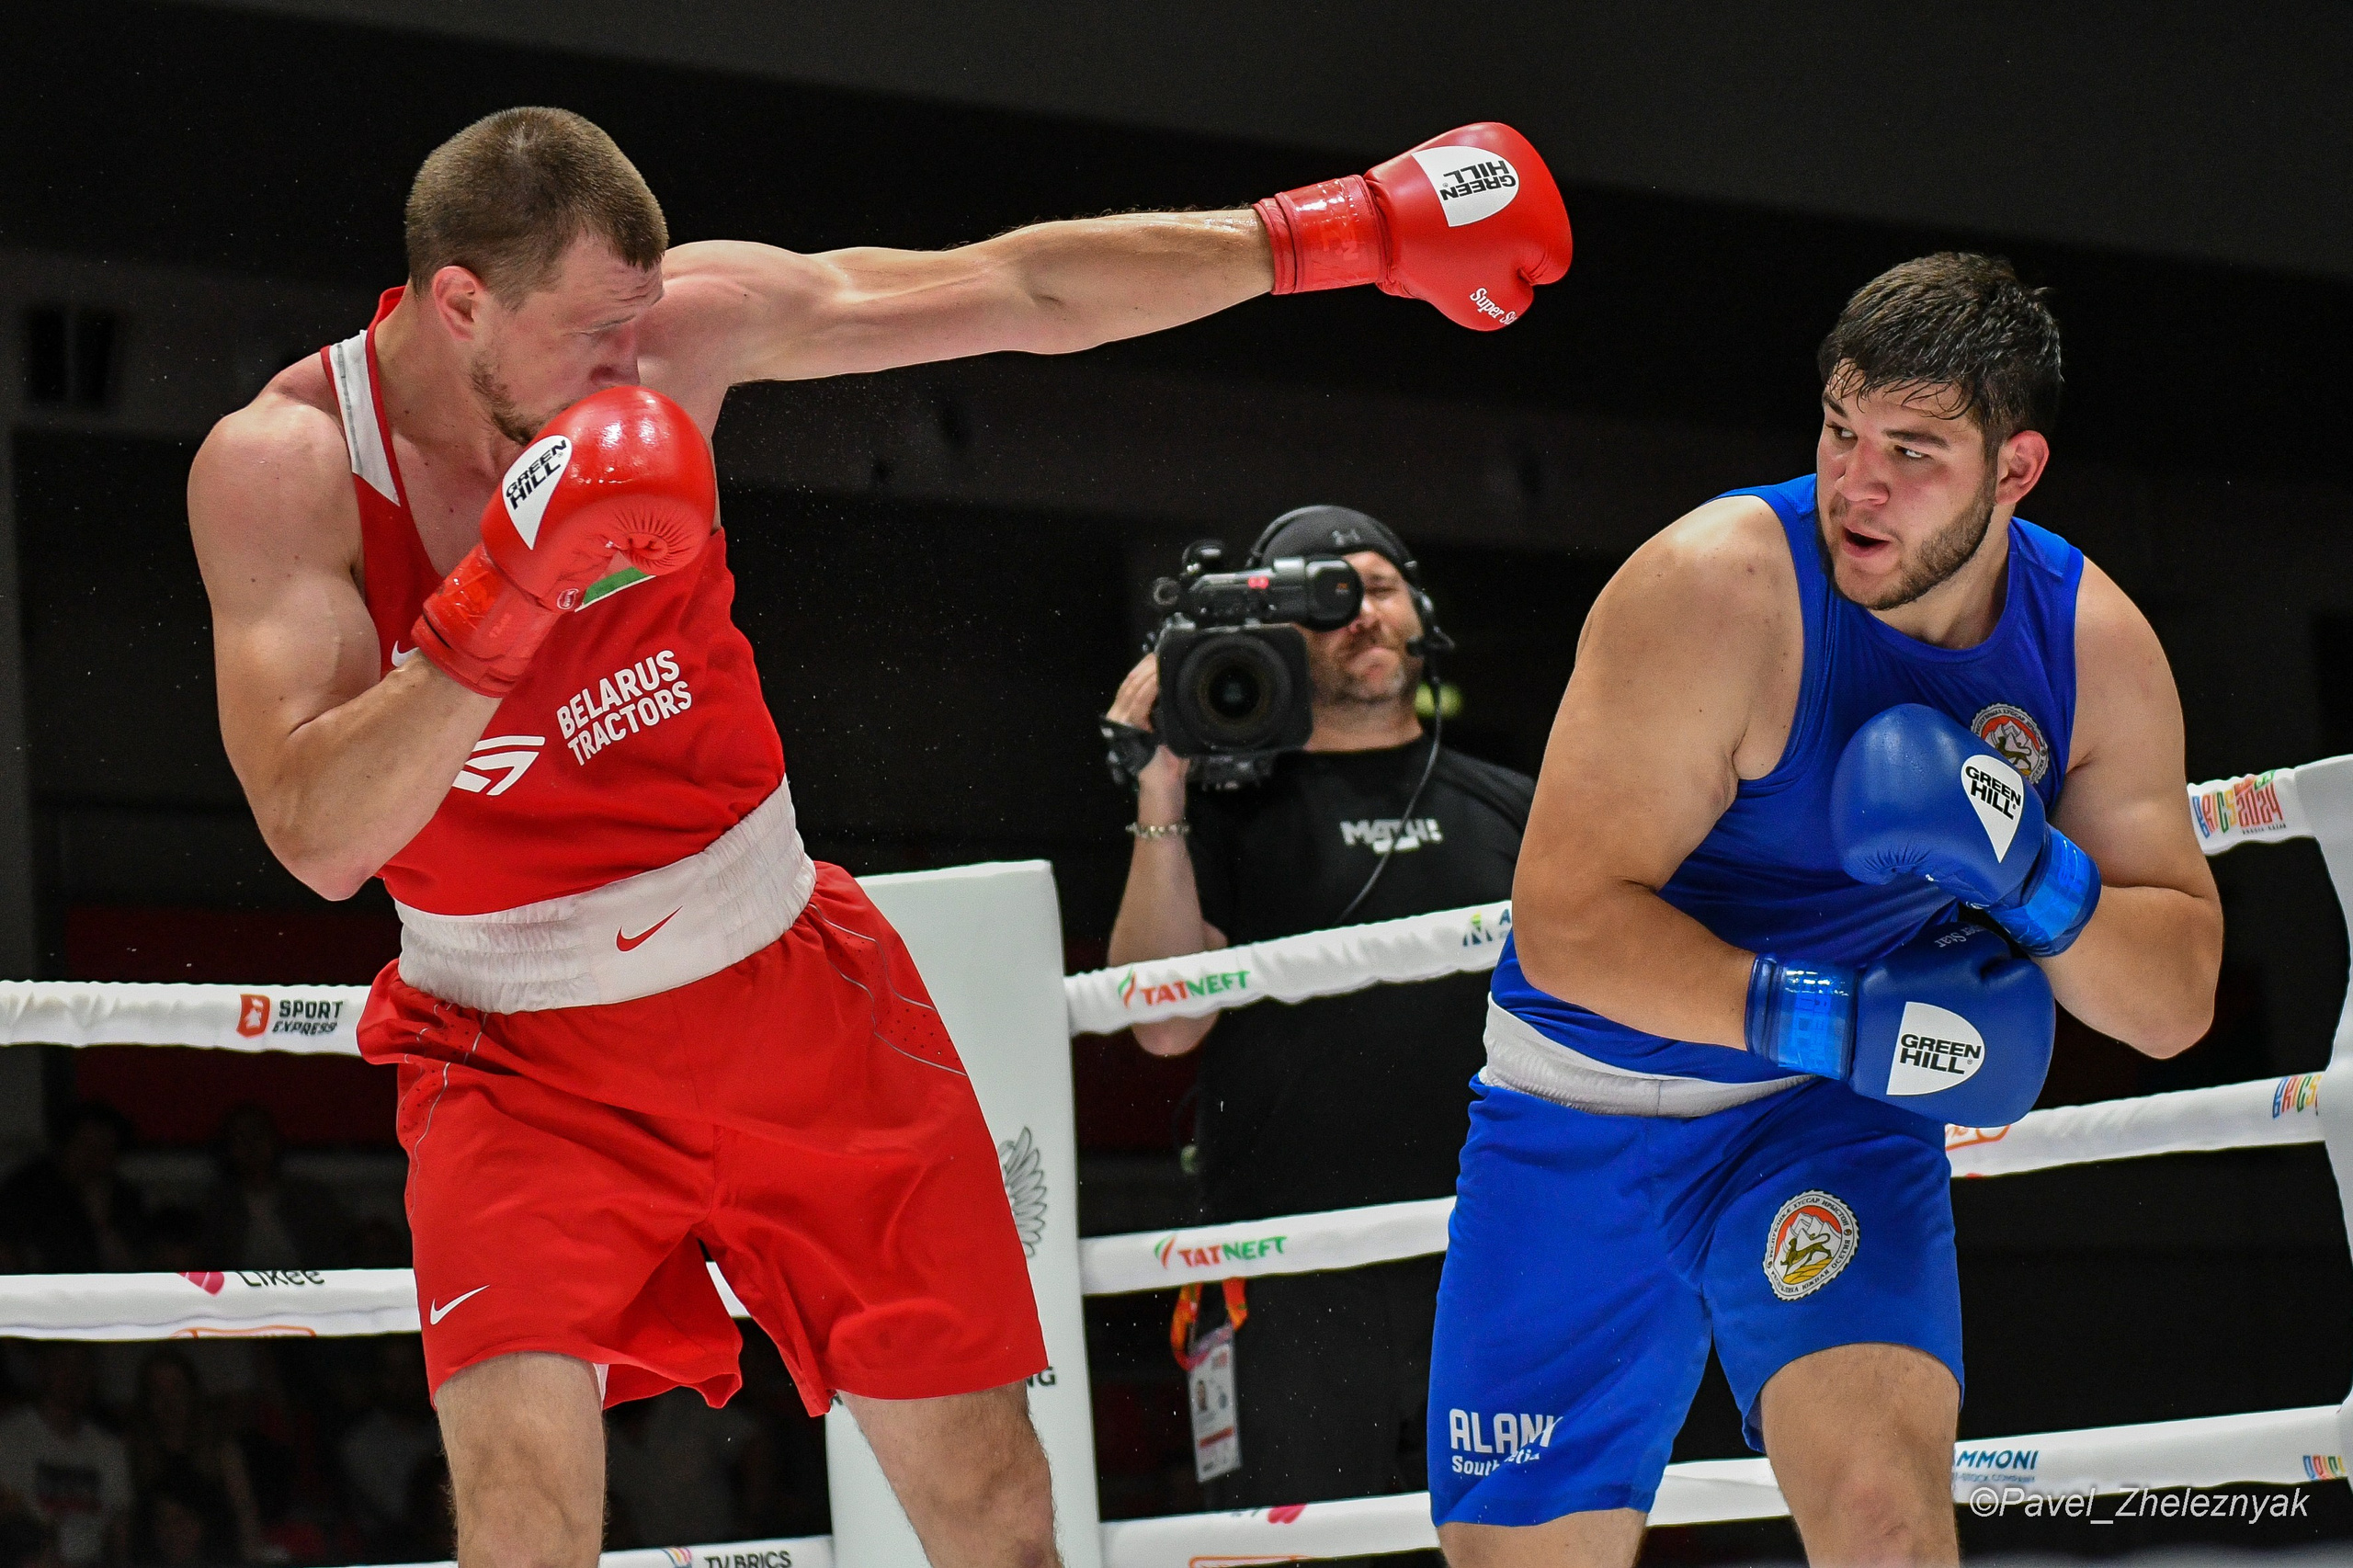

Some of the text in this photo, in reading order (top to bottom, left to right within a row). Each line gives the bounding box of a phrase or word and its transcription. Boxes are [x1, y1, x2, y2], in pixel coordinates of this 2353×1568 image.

[1443, 160, 1510, 182] HILL
[1440, 174, 1517, 201] GREEN
[1469, 287, 1506, 319] Super
[506, 438, 568, 499] GREEN
[509, 459, 563, 510] HILL
[556, 649, 681, 741] BELARUS
[566, 681, 693, 767] TRACTORS
[1965, 765, 2022, 803] GREEN
[1970, 779, 2016, 821] HILL
[2191, 789, 2238, 839] BRICS
[1140, 969, 1251, 1007] TATNEFT
[278, 999, 344, 1019] SPORT
[272, 1019, 338, 1036] EXPRESS
[1899, 1046, 1966, 1075] HILL
[1900, 1033, 1982, 1060] GREEN
[1177, 1234, 1287, 1268] TATNEFT
[1831, 1239, 1851, 1269] ОСЕТИЯ
[1955, 1449, 2040, 1471] MMONI
[703, 1550, 792, 1568] TV BRICS
